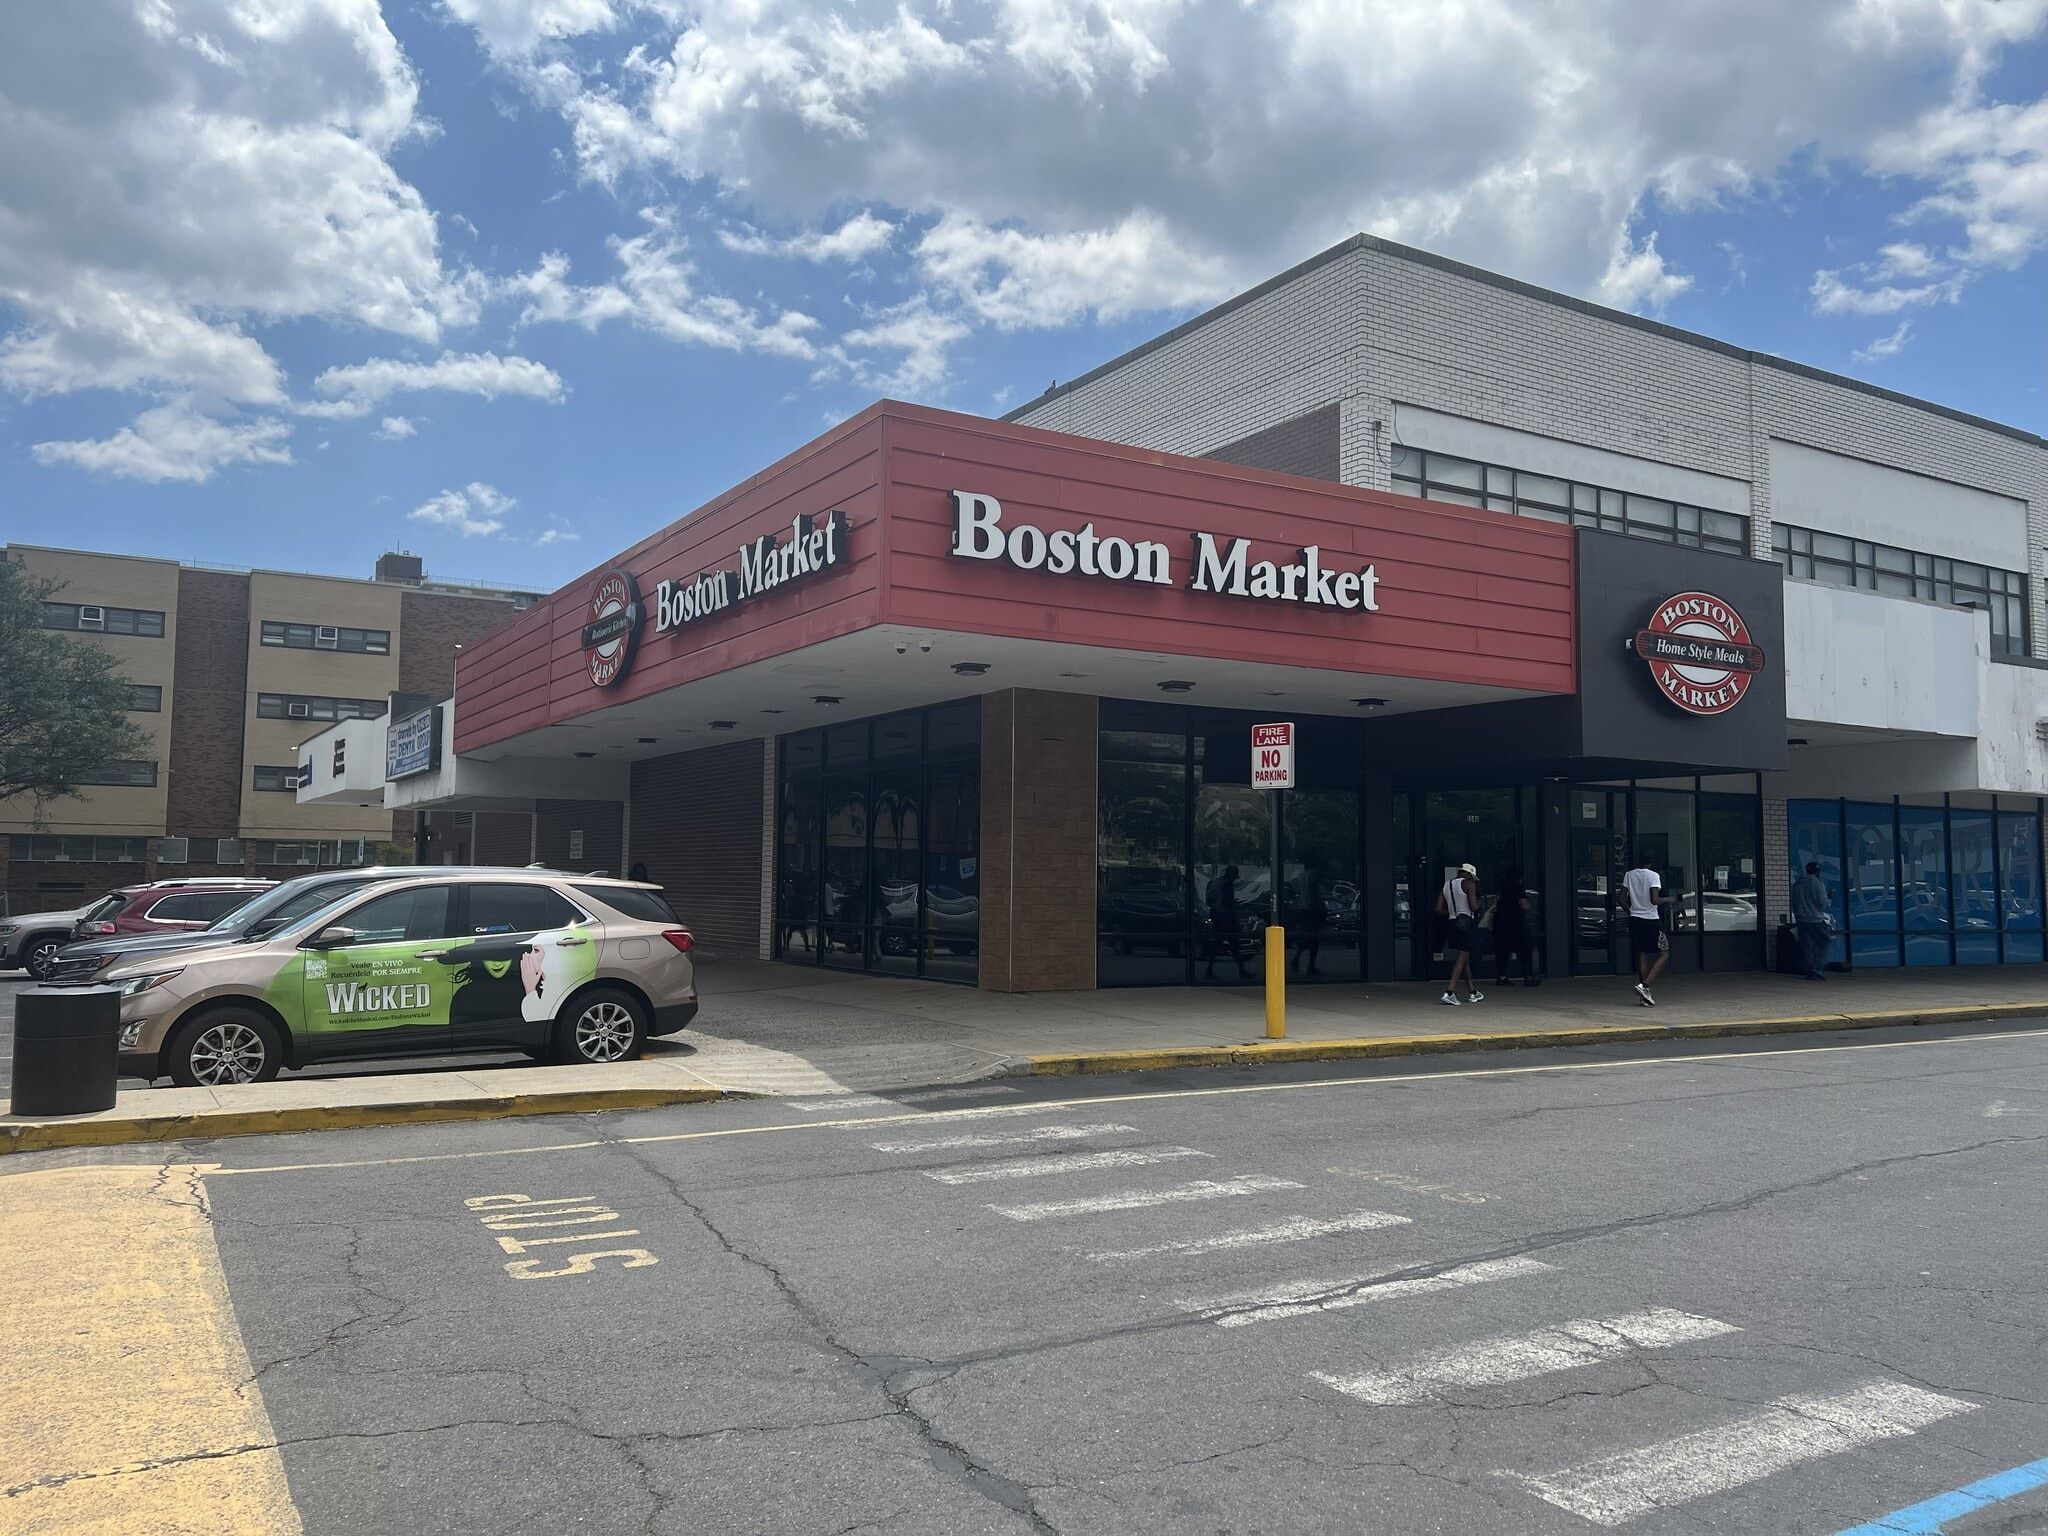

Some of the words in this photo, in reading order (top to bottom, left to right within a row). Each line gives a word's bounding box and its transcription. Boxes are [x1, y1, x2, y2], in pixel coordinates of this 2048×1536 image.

[953, 489, 1173, 585] Boston
[1192, 531, 1380, 611] Market
[655, 571, 730, 633] Boston
[738, 510, 837, 600] Market
[593, 579, 626, 615] BOSTON
[591, 624, 612, 640] Rotisserie
[612, 618, 627, 632] Kitchen
[1661, 599, 1740, 637] BOSTON
[591, 645, 624, 679] MARKET
[1656, 638, 1687, 656] Home
[1688, 643, 1713, 661] Style
[1714, 648, 1745, 664] Meals
[1661, 668, 1741, 707] MARKET
[1256, 735, 1287, 745] LANE
[1259, 726, 1285, 736] FIRE
[1261, 749, 1281, 768] NO
[1255, 769, 1288, 781] PARKING
[331, 969, 371, 979] Recuérdelo
[372, 969, 388, 977] POR
[350, 961, 371, 969] Véalo
[464, 1193, 659, 1280] STOP
